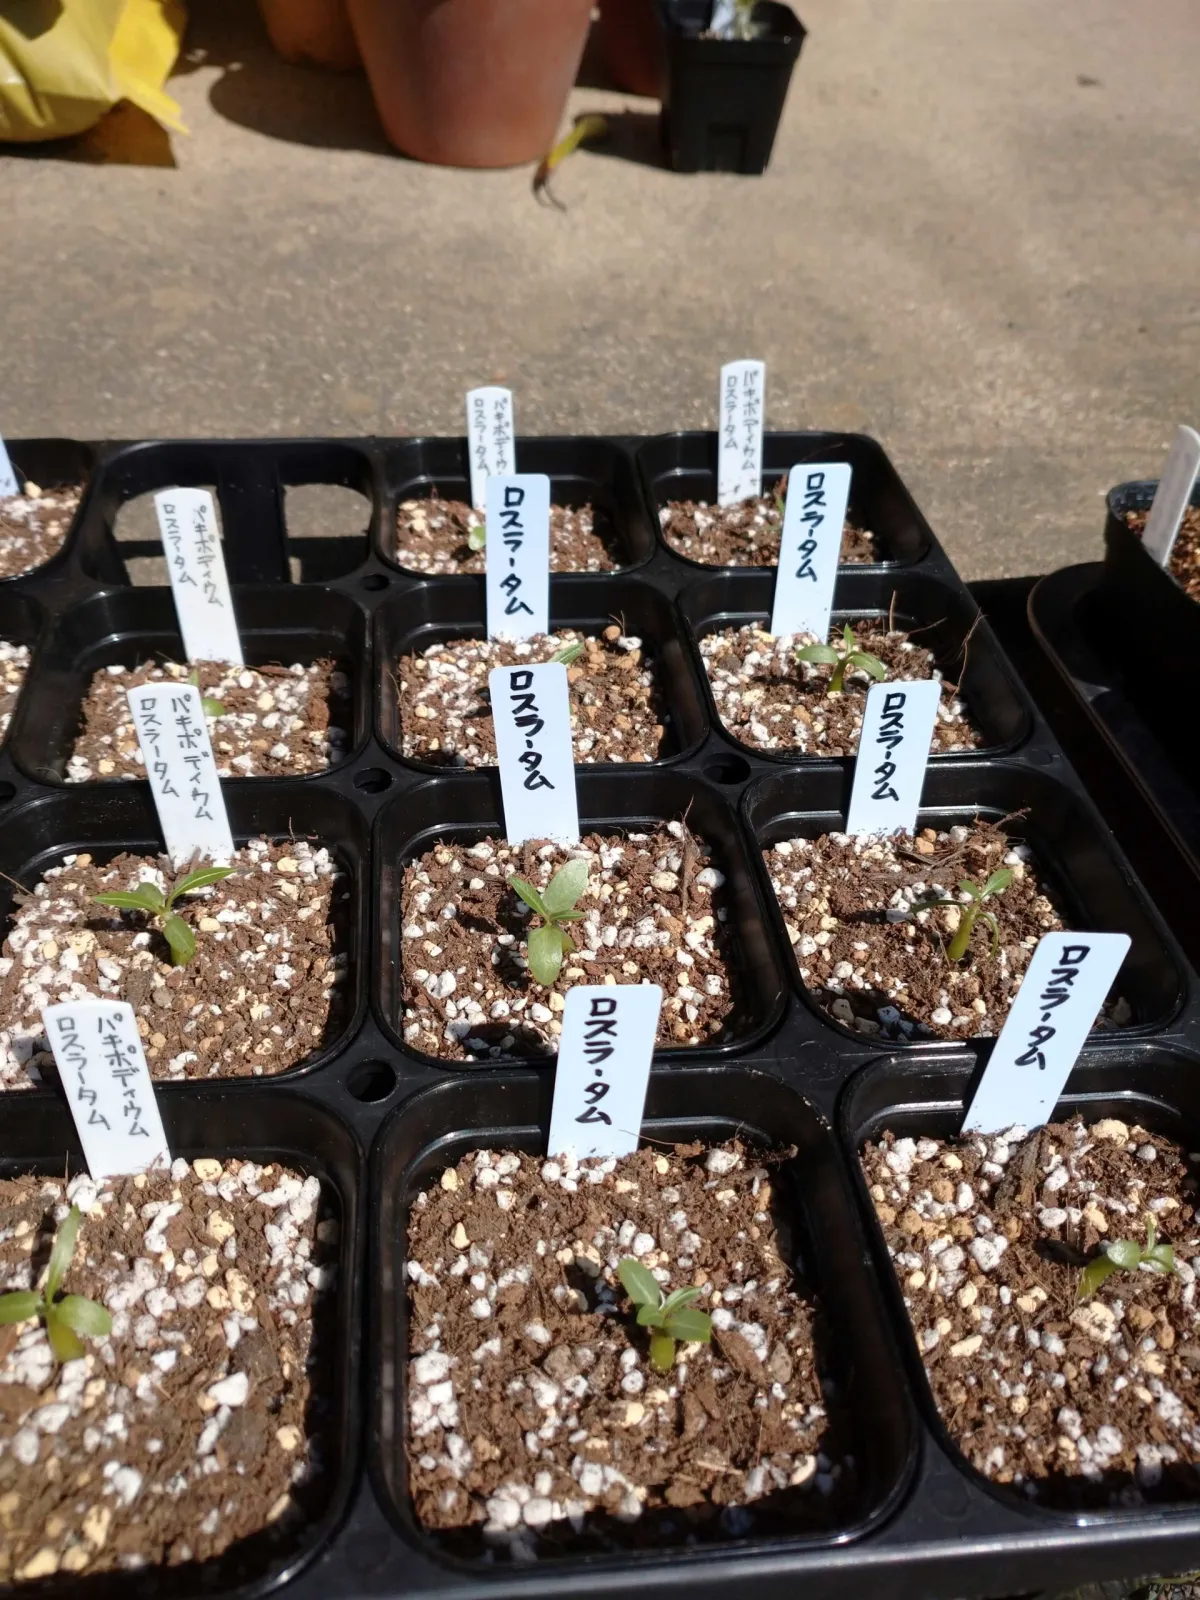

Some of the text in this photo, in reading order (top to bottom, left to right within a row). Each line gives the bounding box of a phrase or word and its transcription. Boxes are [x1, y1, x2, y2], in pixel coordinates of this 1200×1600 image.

[493, 397, 511, 475] パキポディウ
[724, 375, 739, 449] ロスラータム
[163, 503, 198, 587] ロスラータム
[499, 486, 534, 615] ロスラータム
[795, 472, 827, 582] ロスラータム
[140, 698, 180, 797] ロスラータム
[171, 693, 213, 821] パキポディウム
[510, 670, 555, 790] ロスラータム
[871, 692, 906, 801] ロスラータム
[1015, 945, 1091, 1070] ロスラータム
[56, 1016, 111, 1130] ロスラータム
[98, 1013, 150, 1137] パキポディウム
